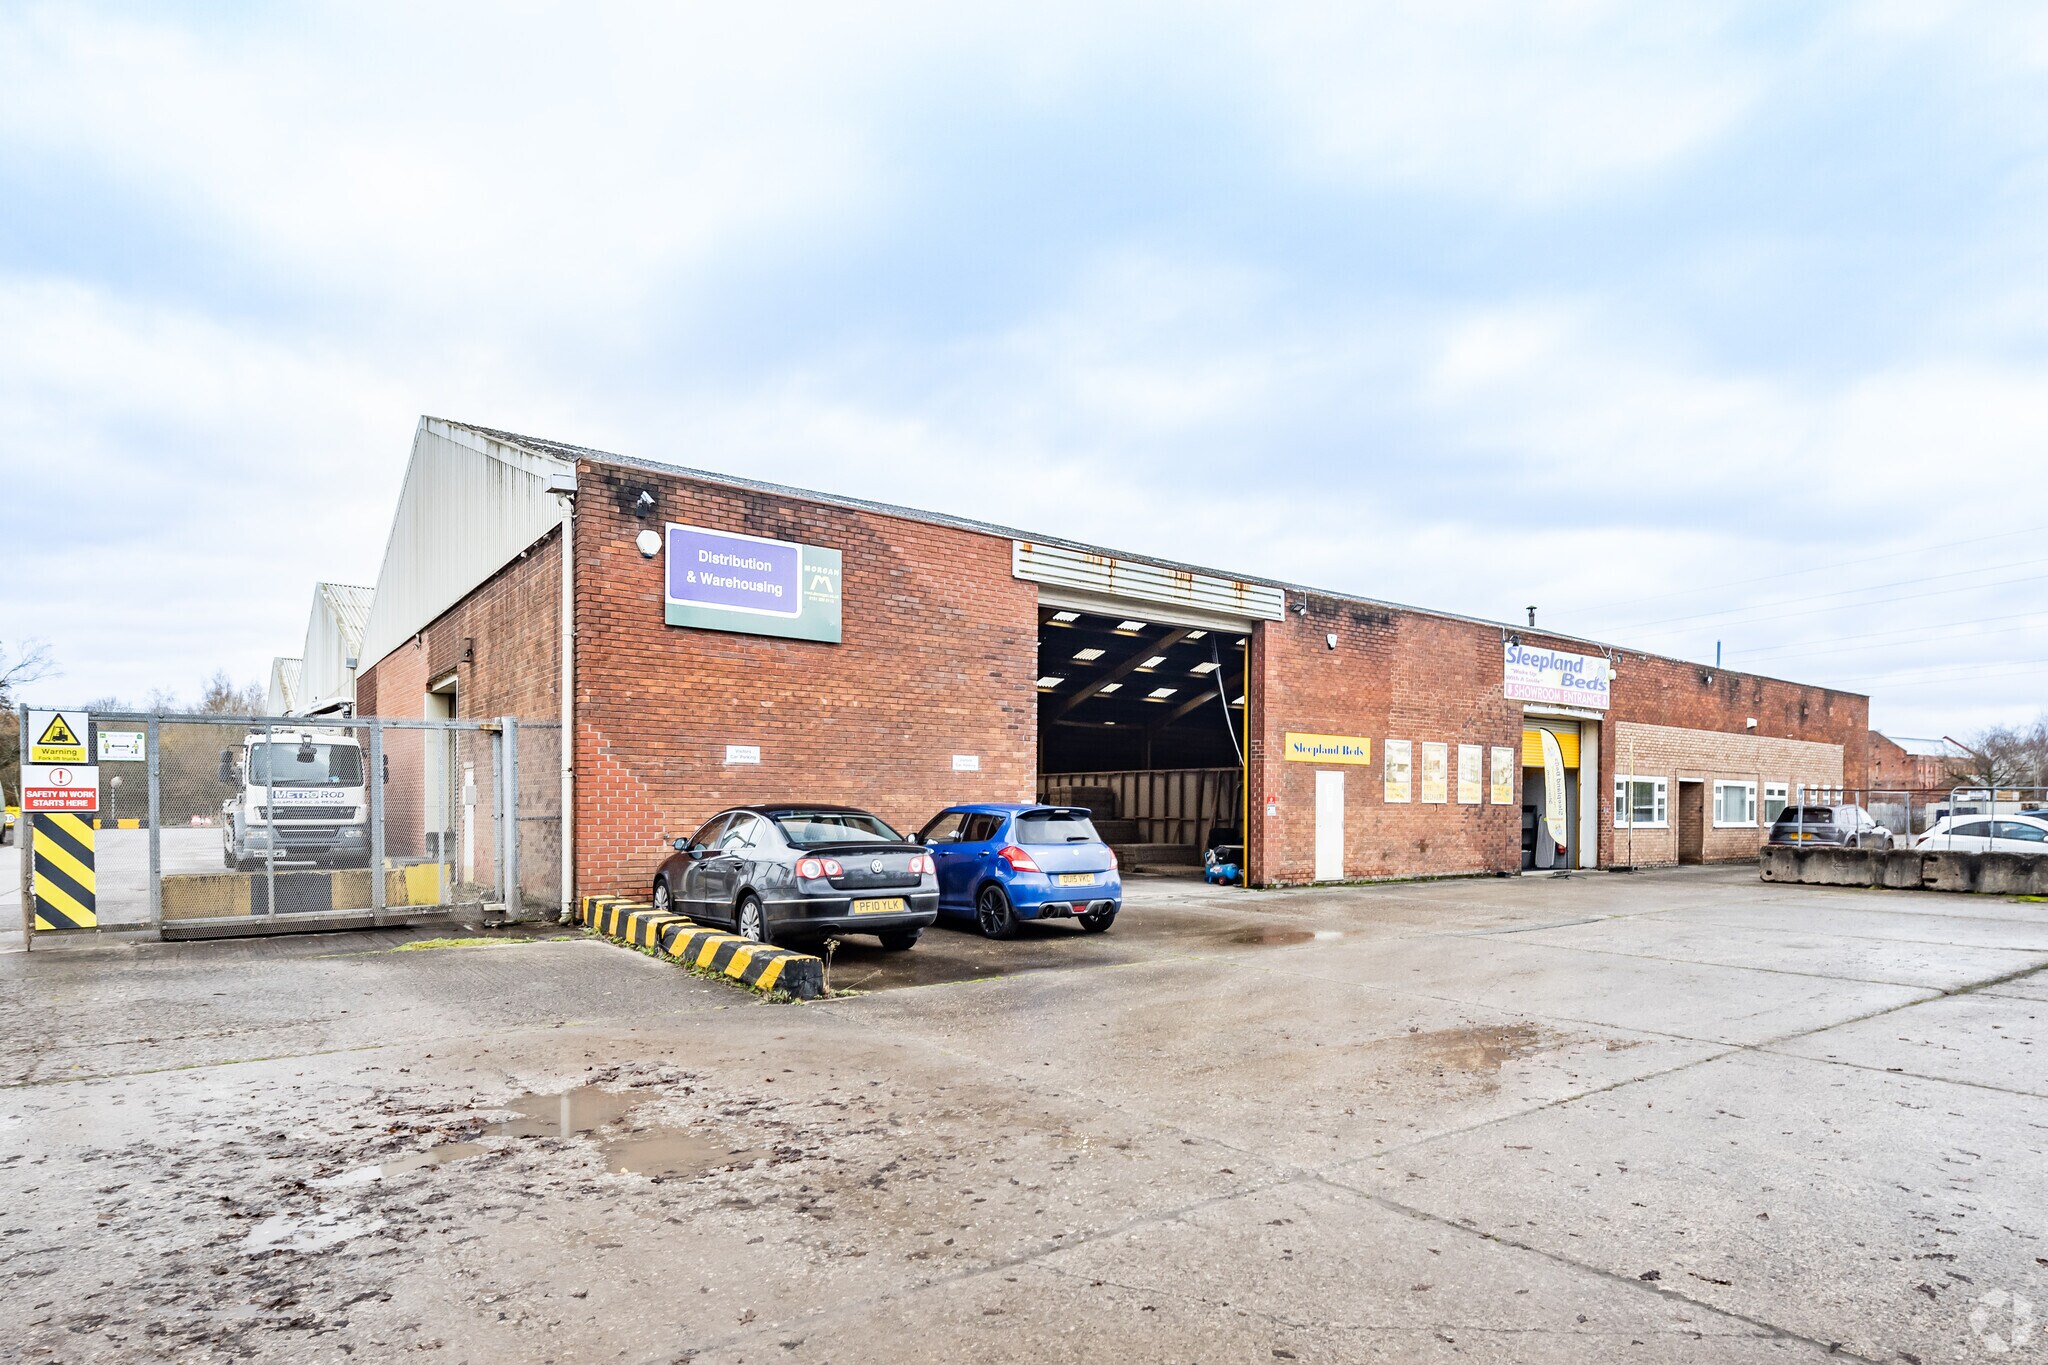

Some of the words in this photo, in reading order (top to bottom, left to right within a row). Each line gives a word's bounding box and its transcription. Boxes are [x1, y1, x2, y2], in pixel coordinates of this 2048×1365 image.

[698, 549, 772, 572] Distribution
[804, 564, 839, 576] MORGAN
[686, 570, 697, 583] &
[699, 571, 783, 597] Warehousing
[1506, 645, 1584, 674] Sleepland
[1561, 672, 1607, 692] Beds
[1514, 685, 1560, 702] SHOWROOM
[1563, 690, 1602, 706] ENTRANCE
[41, 748, 78, 756] Warning
[1293, 742, 1339, 757] Sleepland
[1342, 745, 1364, 756] Beds
[26, 790, 58, 798] SAFETY
[274, 791, 319, 799] METRO
[321, 790, 345, 798] ROD
[32, 799, 65, 807] STARTS
[859, 901, 880, 911] PF10
[882, 900, 899, 910] YLK
